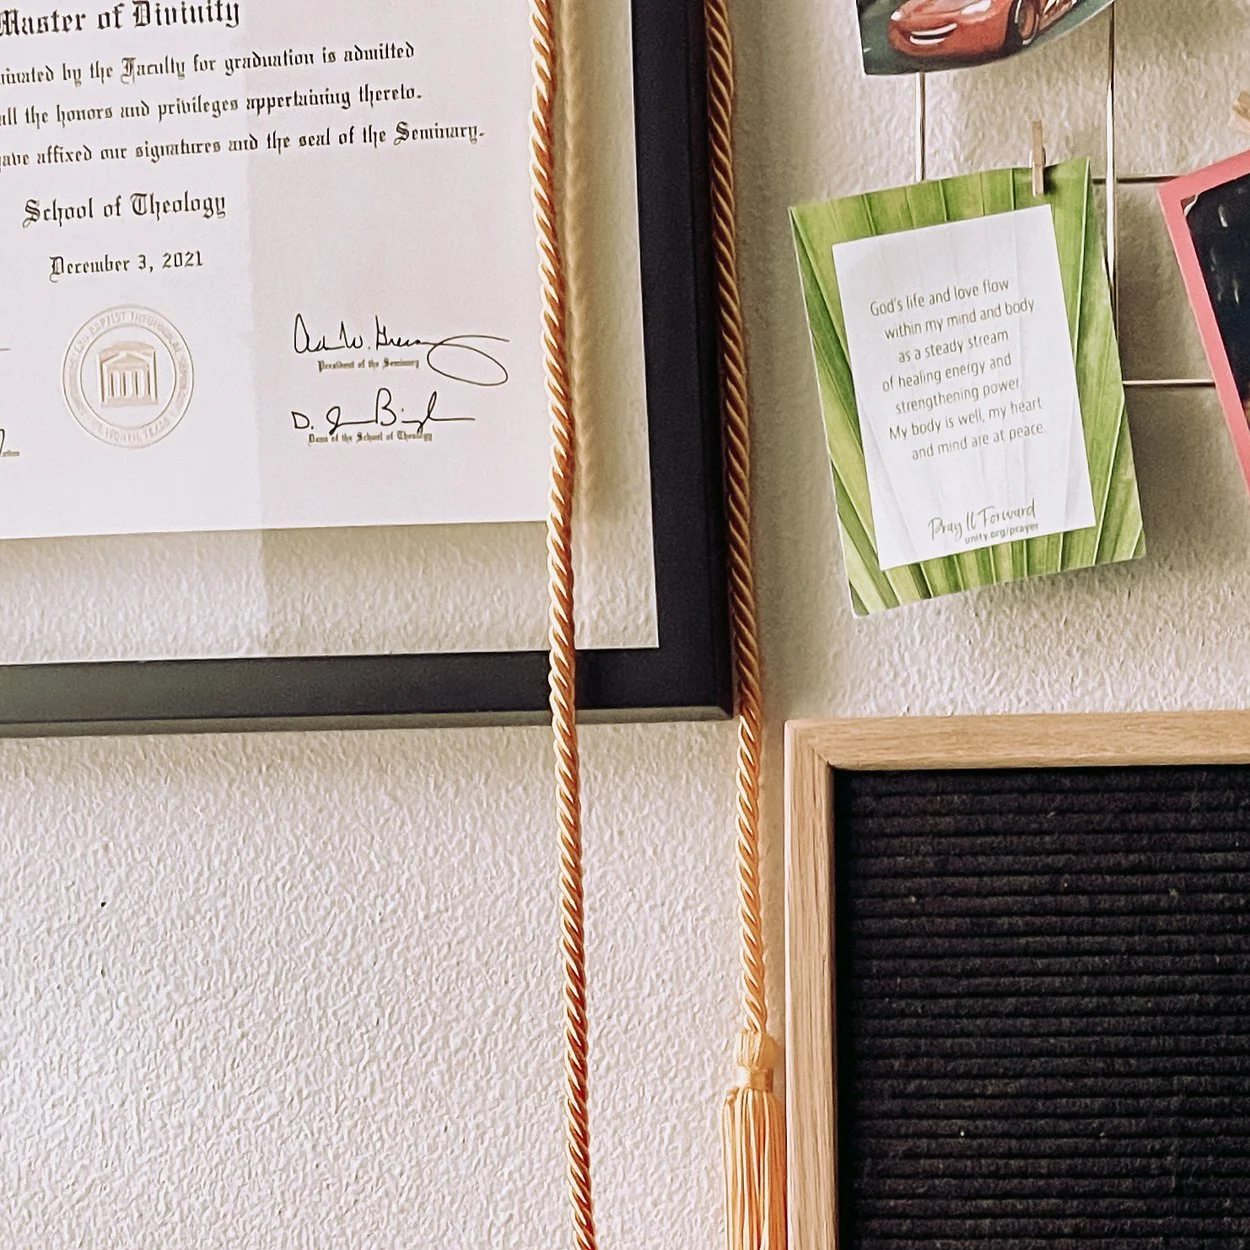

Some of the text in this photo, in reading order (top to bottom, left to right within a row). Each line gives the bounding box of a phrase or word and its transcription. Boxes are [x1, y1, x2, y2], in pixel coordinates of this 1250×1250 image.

[0, 0, 241, 37] Master of Divinity
[62, 62, 82, 88] by
[90, 60, 113, 84] the
[120, 56, 186, 84] Faculty
[193, 54, 216, 72] for
[224, 48, 315, 77] graduation
[322, 46, 336, 64] is
[344, 42, 415, 62] admitted
[24, 105, 48, 129] the
[56, 103, 113, 128] honors
[120, 100, 150, 119] and
[158, 94, 239, 122] privileges
[247, 88, 351, 116] appertaining
[359, 83, 422, 108] thereto.
[0, 121, 485, 173] ave affixed our signatures and the seal of the Seminary.
[22, 191, 226, 228] School of Theology
[48, 250, 203, 283] December 3, 2021
[870, 279, 1009, 317] God's life and love flow
[884, 298, 1034, 340] within my mind and body
[898, 330, 1009, 364] as a steady stream
[882, 353, 1012, 392] of healing energy and
[889, 397, 1042, 441] My body is well, my heart
[895, 386, 980, 415] strengthening
[912, 444, 934, 461] and
[938, 437, 968, 454] mind
[971, 434, 989, 449] are
[993, 430, 1005, 443] at
[928, 516, 963, 540] Pray
[977, 497, 1036, 528] Forward
